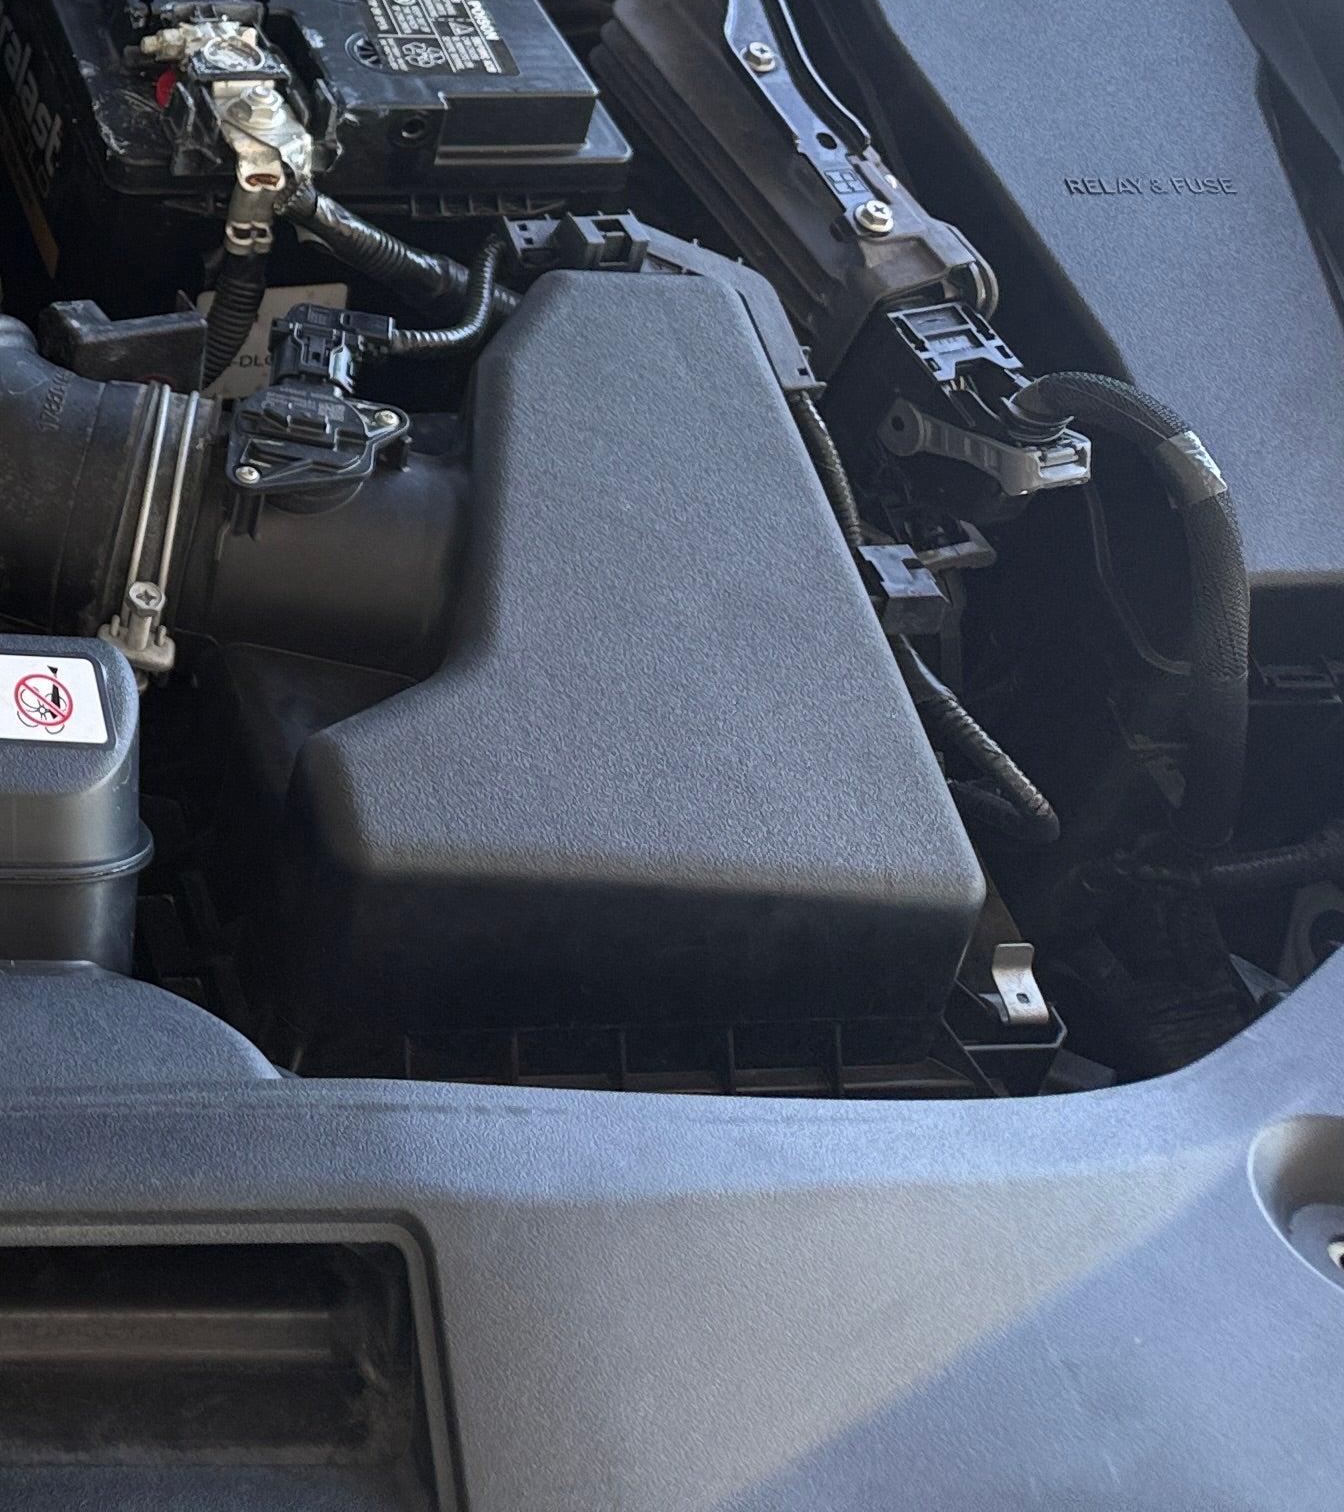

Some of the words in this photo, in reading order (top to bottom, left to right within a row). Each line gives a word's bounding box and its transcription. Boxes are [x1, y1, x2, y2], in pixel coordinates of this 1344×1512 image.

[1064, 177, 1143, 196] RELAY
[1150, 179, 1167, 195] &
[1170, 178, 1237, 196] FUSE
